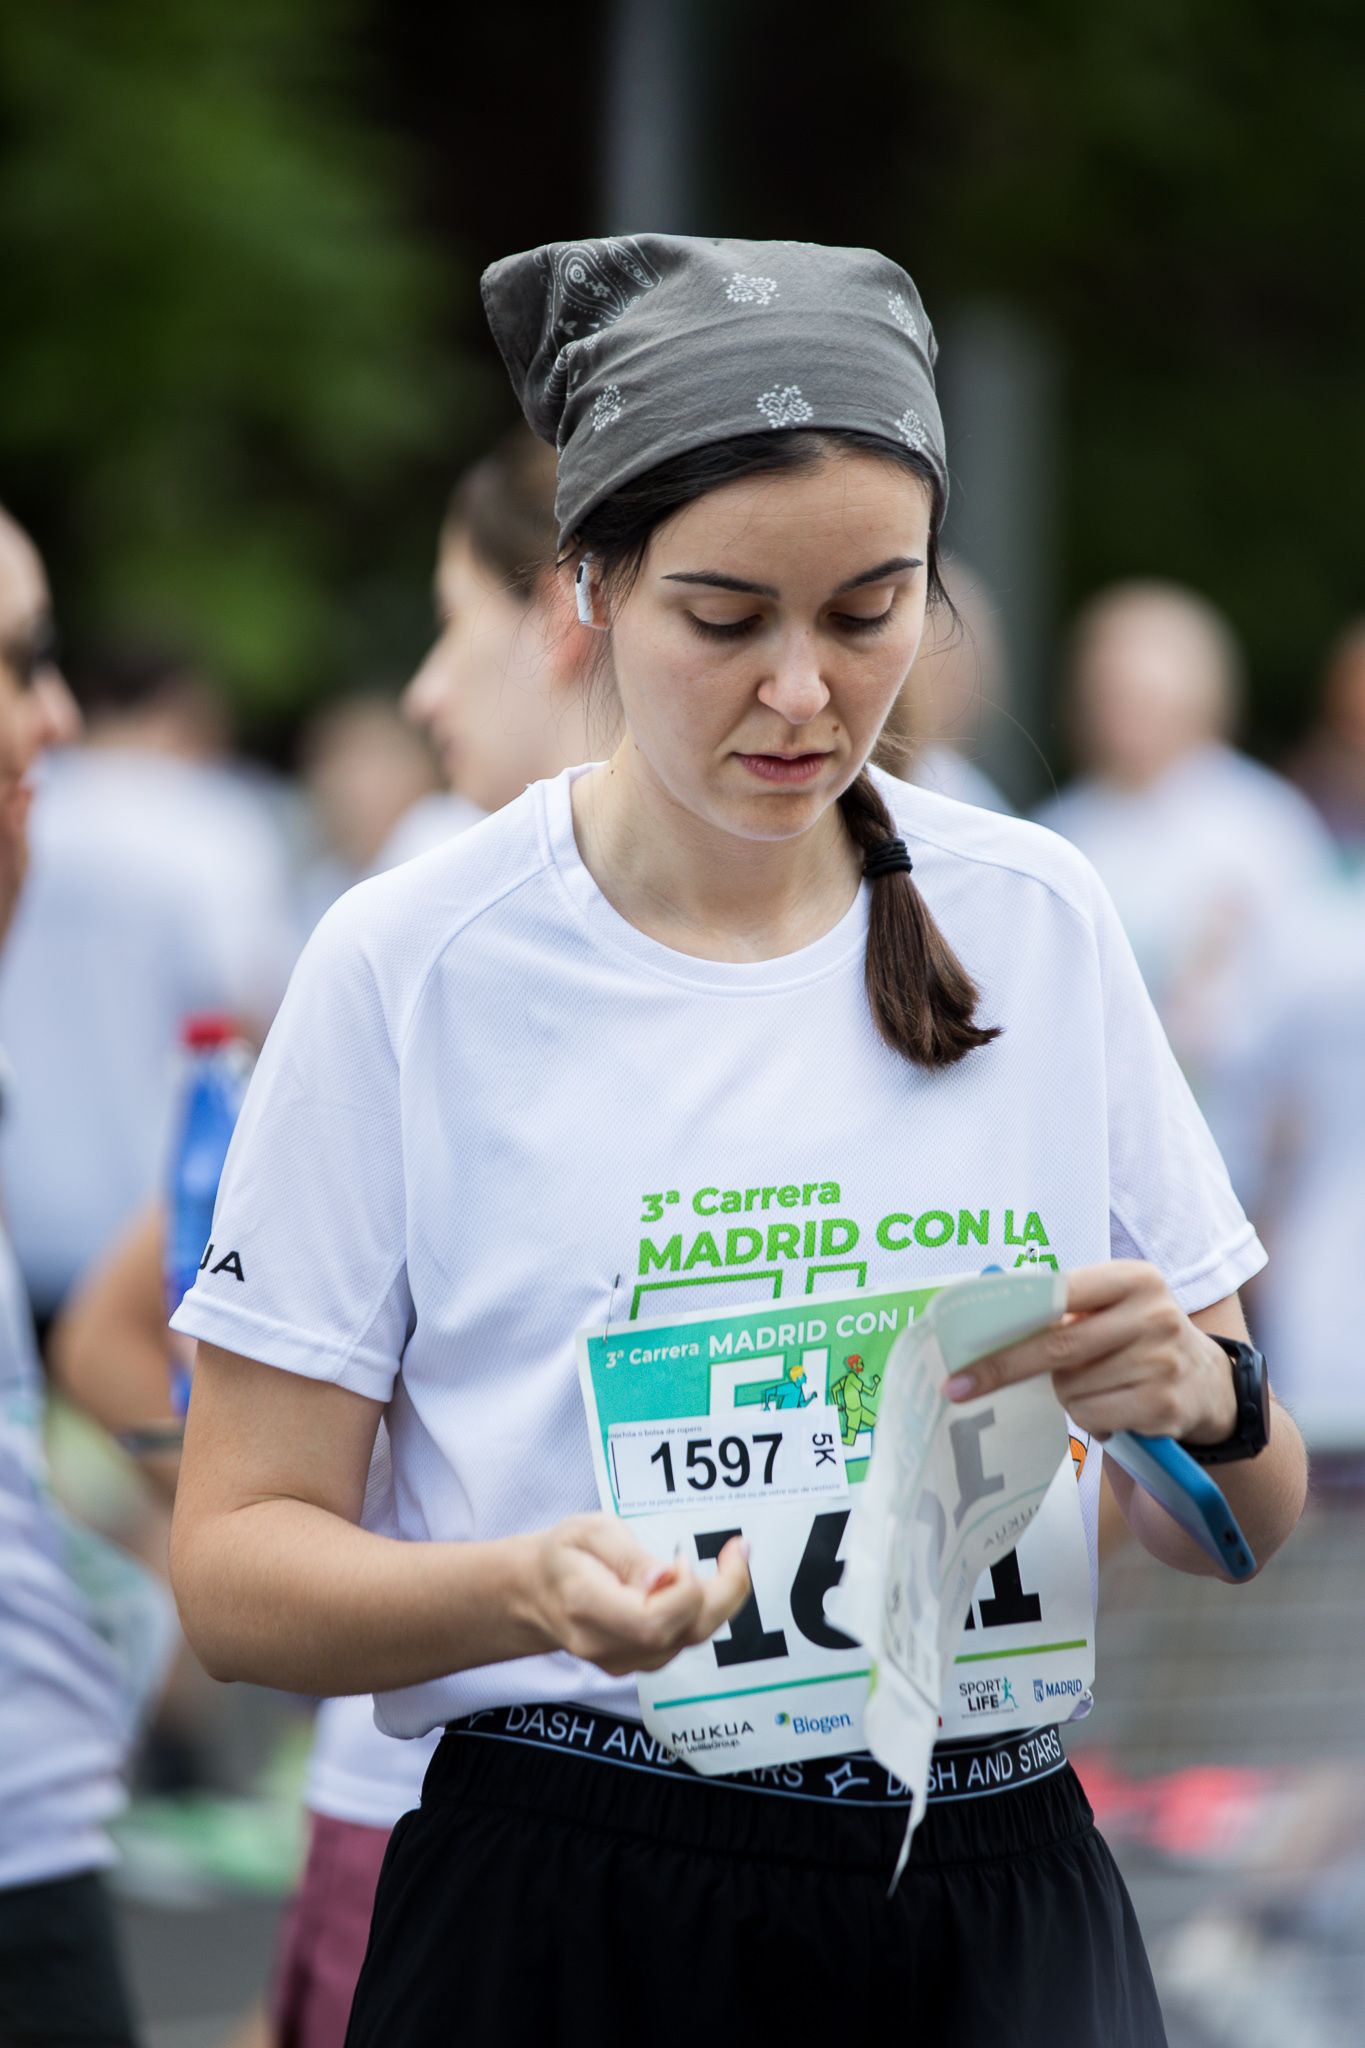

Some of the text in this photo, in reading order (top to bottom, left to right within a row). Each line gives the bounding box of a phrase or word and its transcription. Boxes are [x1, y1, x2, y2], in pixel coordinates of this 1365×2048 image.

[639, 1180, 841, 1222] 3ª Carrera
[637, 1208, 1050, 1275] MADRID CON LA
[605, 1349, 625, 1369] 3ª
[629, 1341, 699, 1366] Carrera
[709, 1320, 827, 1358] MADRID
[836, 1306, 899, 1338] CON
[650, 1432, 783, 1493] 1597
[812, 1432, 837, 1468] 5K
[959, 1678, 1001, 1697] SPORT
[967, 1694, 1000, 1712] LIFE
[1045, 1679, 1082, 1697] MADRID
[505, 1704, 595, 1746] DASH
[671, 1721, 754, 1744] MUKUA
[967, 1751, 1013, 1788] AND
[1018, 1728, 1061, 1774] STARS
